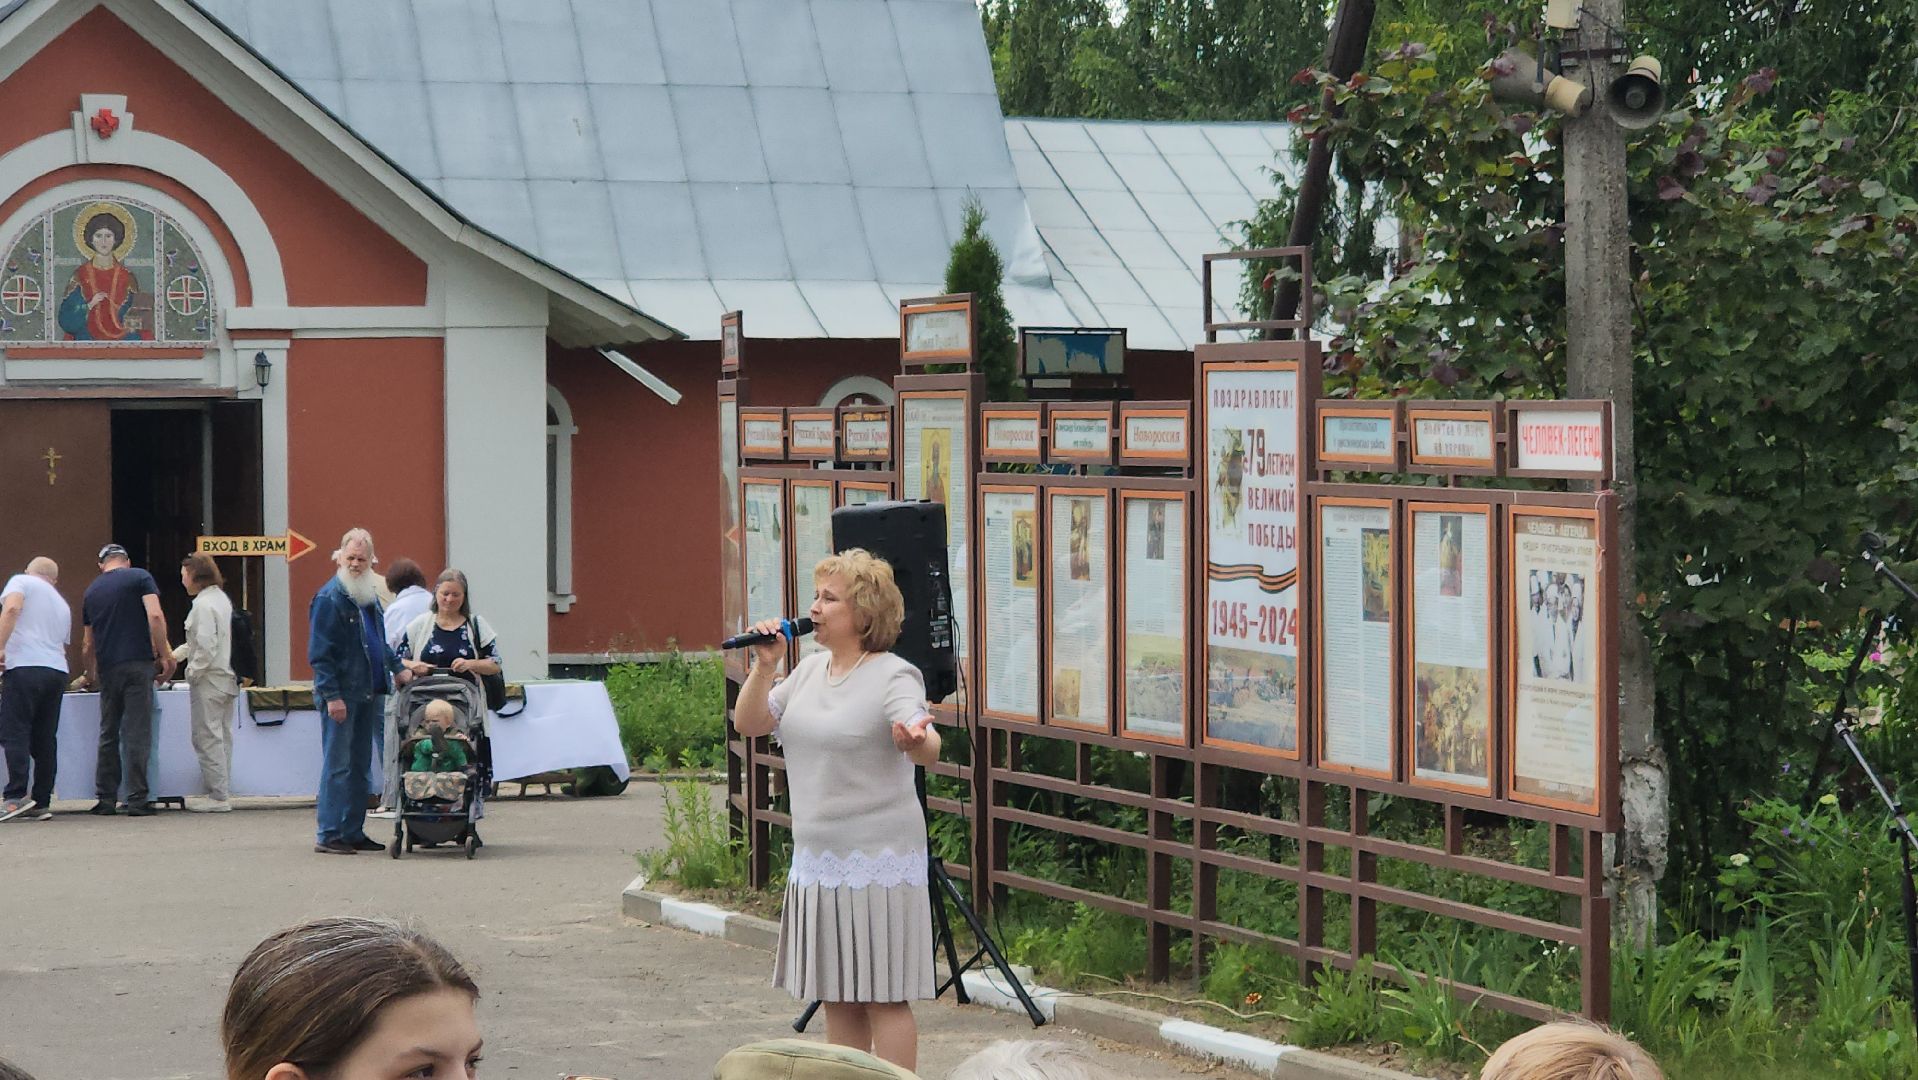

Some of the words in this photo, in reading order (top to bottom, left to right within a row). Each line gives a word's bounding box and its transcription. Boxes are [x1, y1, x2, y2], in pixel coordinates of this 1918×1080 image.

[1133, 426, 1181, 447] Новороссия
[1248, 484, 1295, 512] ВЕЛИКОЙ
[202, 541, 238, 552] ВХОД
[243, 541, 249, 551] В
[252, 541, 286, 551] ХРАМ
[1248, 523, 1296, 551] ПОБЕДЫ
